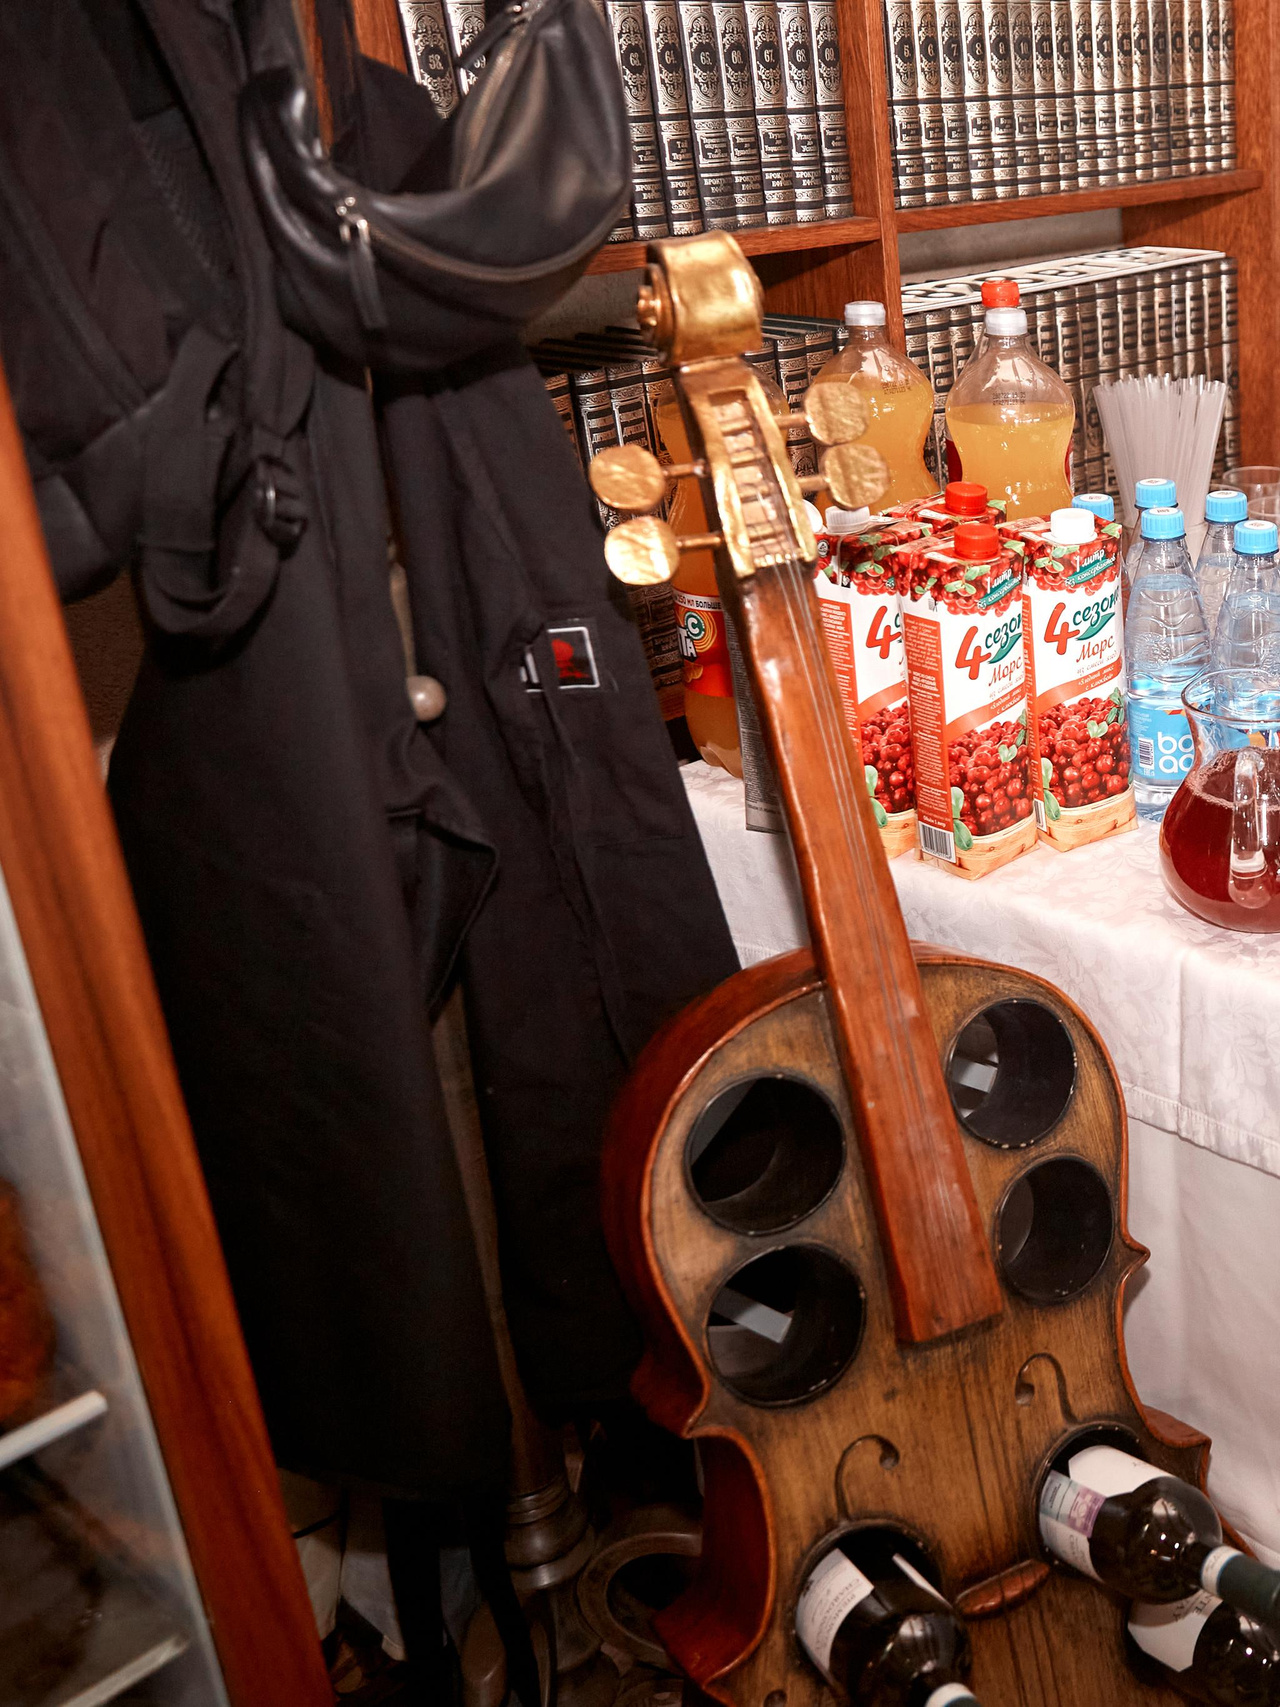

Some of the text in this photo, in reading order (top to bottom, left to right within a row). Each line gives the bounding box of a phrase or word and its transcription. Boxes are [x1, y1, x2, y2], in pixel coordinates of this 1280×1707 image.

[865, 605, 902, 660] 4
[955, 625, 992, 681] 4
[1043, 602, 1081, 656] 4
[1075, 635, 1115, 663] Морс
[987, 656, 1023, 687] Морс
